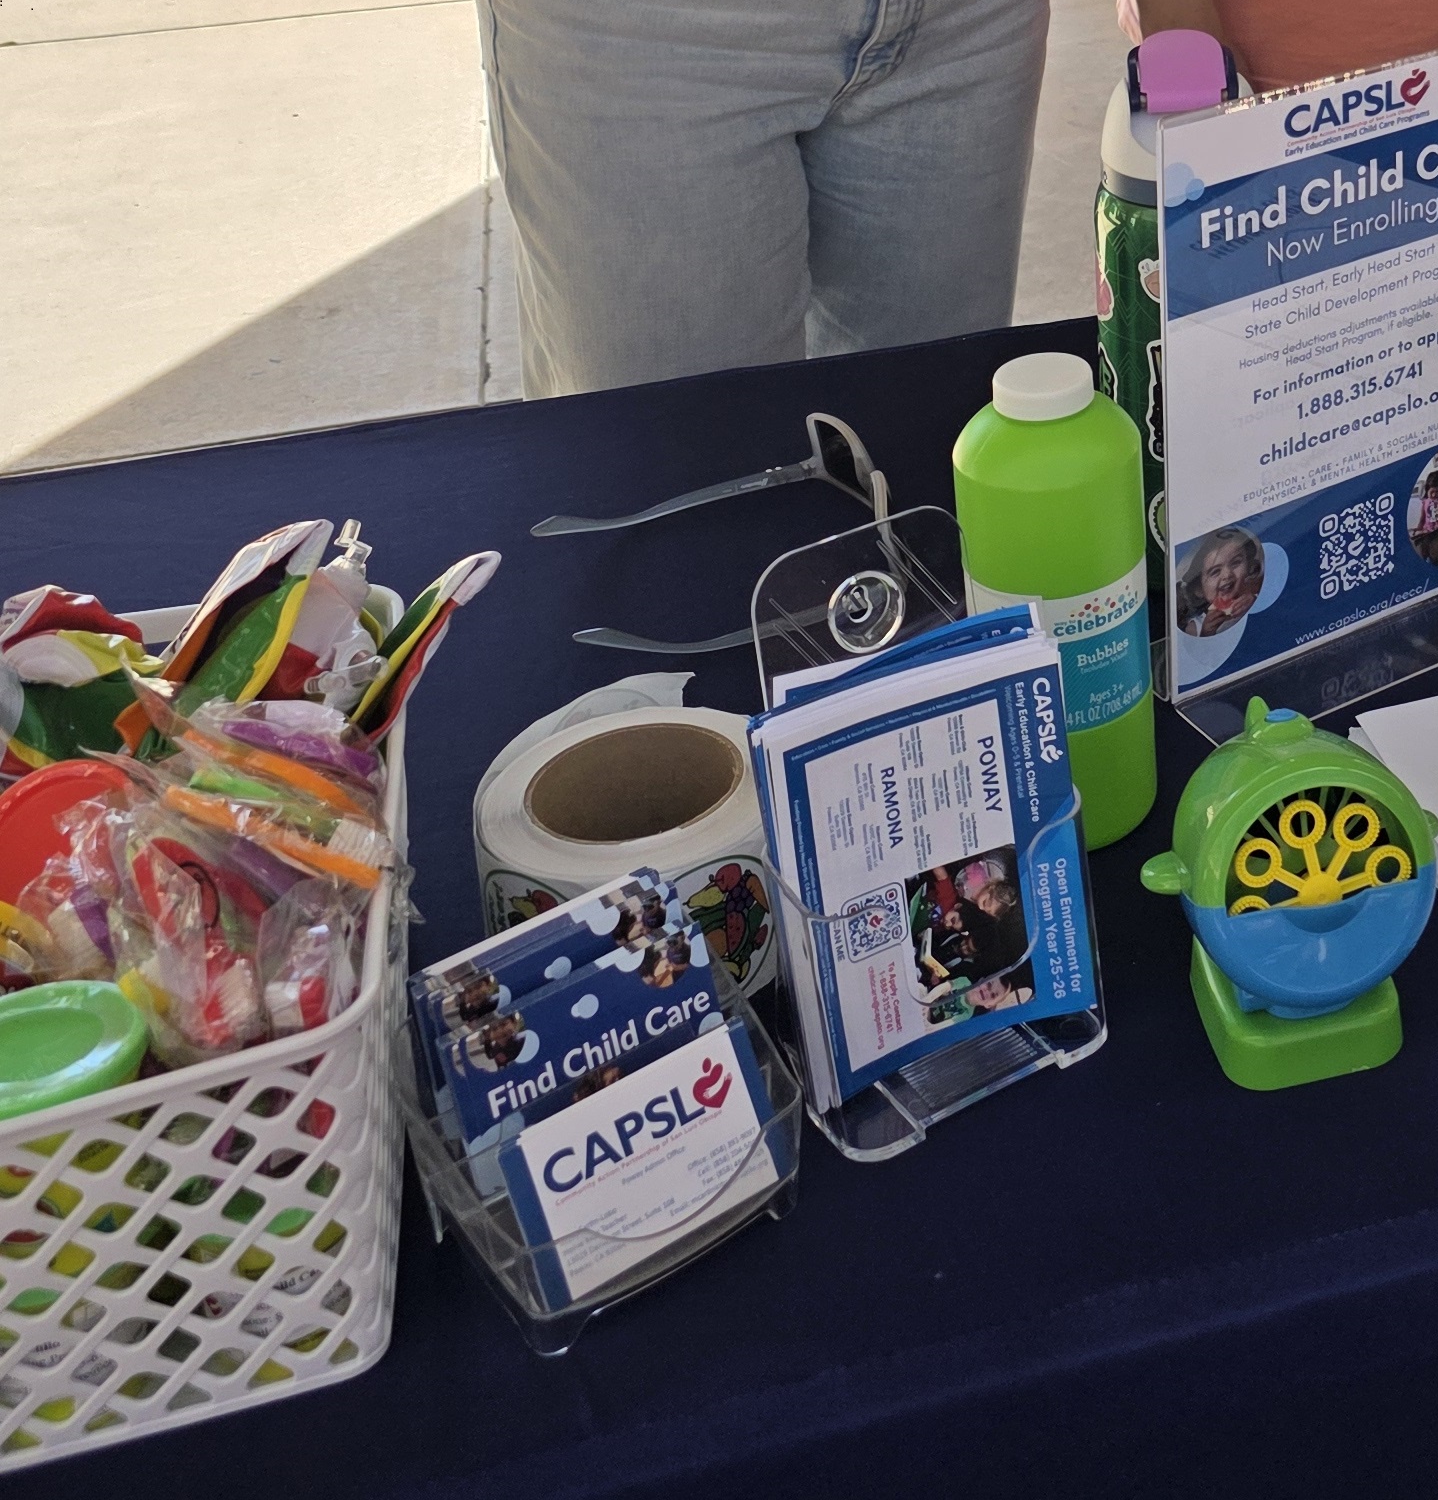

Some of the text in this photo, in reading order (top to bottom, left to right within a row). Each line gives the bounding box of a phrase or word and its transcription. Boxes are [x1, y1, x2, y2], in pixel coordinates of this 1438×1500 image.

[1200, 185, 1287, 249] Find
[1300, 151, 1404, 214] Child
[1252, 288, 1287, 312] Head
[1291, 278, 1327, 299] Start,
[1332, 266, 1364, 286] Early
[1367, 252, 1400, 275] Head
[1404, 242, 1435, 262] Start
[1267, 233, 1323, 266] Now
[1244, 319, 1281, 339] State
[1285, 301, 1320, 324] Child
[1324, 275, 1408, 312] Development
[1253, 386, 1279, 404] For
[1283, 354, 1373, 393] information
[1377, 346, 1394, 359] or
[1397, 340, 1412, 353] to
[1297, 360, 1422, 418] 1.888.315.6741
[1053, 591, 1138, 637] celebrate!
[1295, 578, 1430, 645] www.capslo.org/eecc/
[1077, 638, 1129, 667] Bubbles
[1090, 684, 1124, 704] Ages 3+
[881, 766, 903, 848] RAMONA
[977, 736, 1003, 813] POWAY
[1037, 863, 1066, 999] Program Year 25-26
[1054, 858, 1082, 993] Open Enrollment for
[486, 990, 711, 1119] Find Child Care
